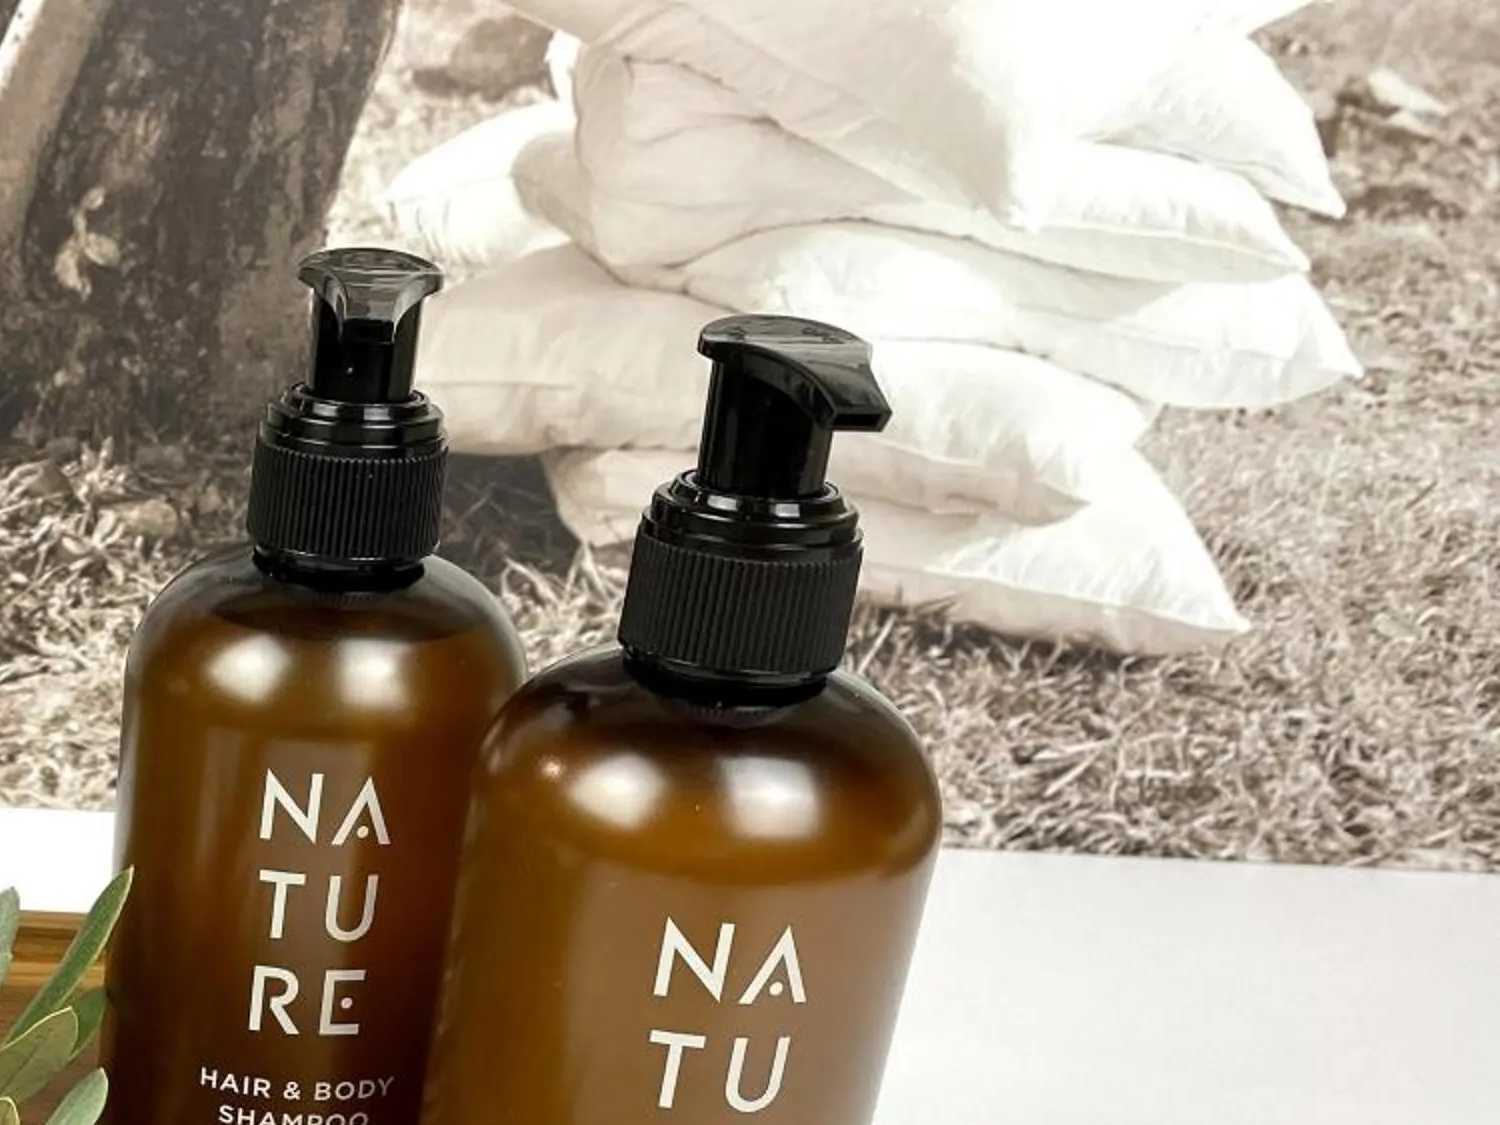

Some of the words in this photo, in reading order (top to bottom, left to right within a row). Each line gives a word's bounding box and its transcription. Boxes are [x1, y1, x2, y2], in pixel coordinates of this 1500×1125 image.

[259, 767, 390, 846] NA
[259, 869, 378, 942] TU
[653, 916, 806, 1004] NA
[248, 965, 367, 1035] RE
[200, 1066, 271, 1098] HAIR
[283, 1081, 300, 1100] &
[314, 1076, 394, 1101] BODY
[649, 1029, 791, 1113] TU
